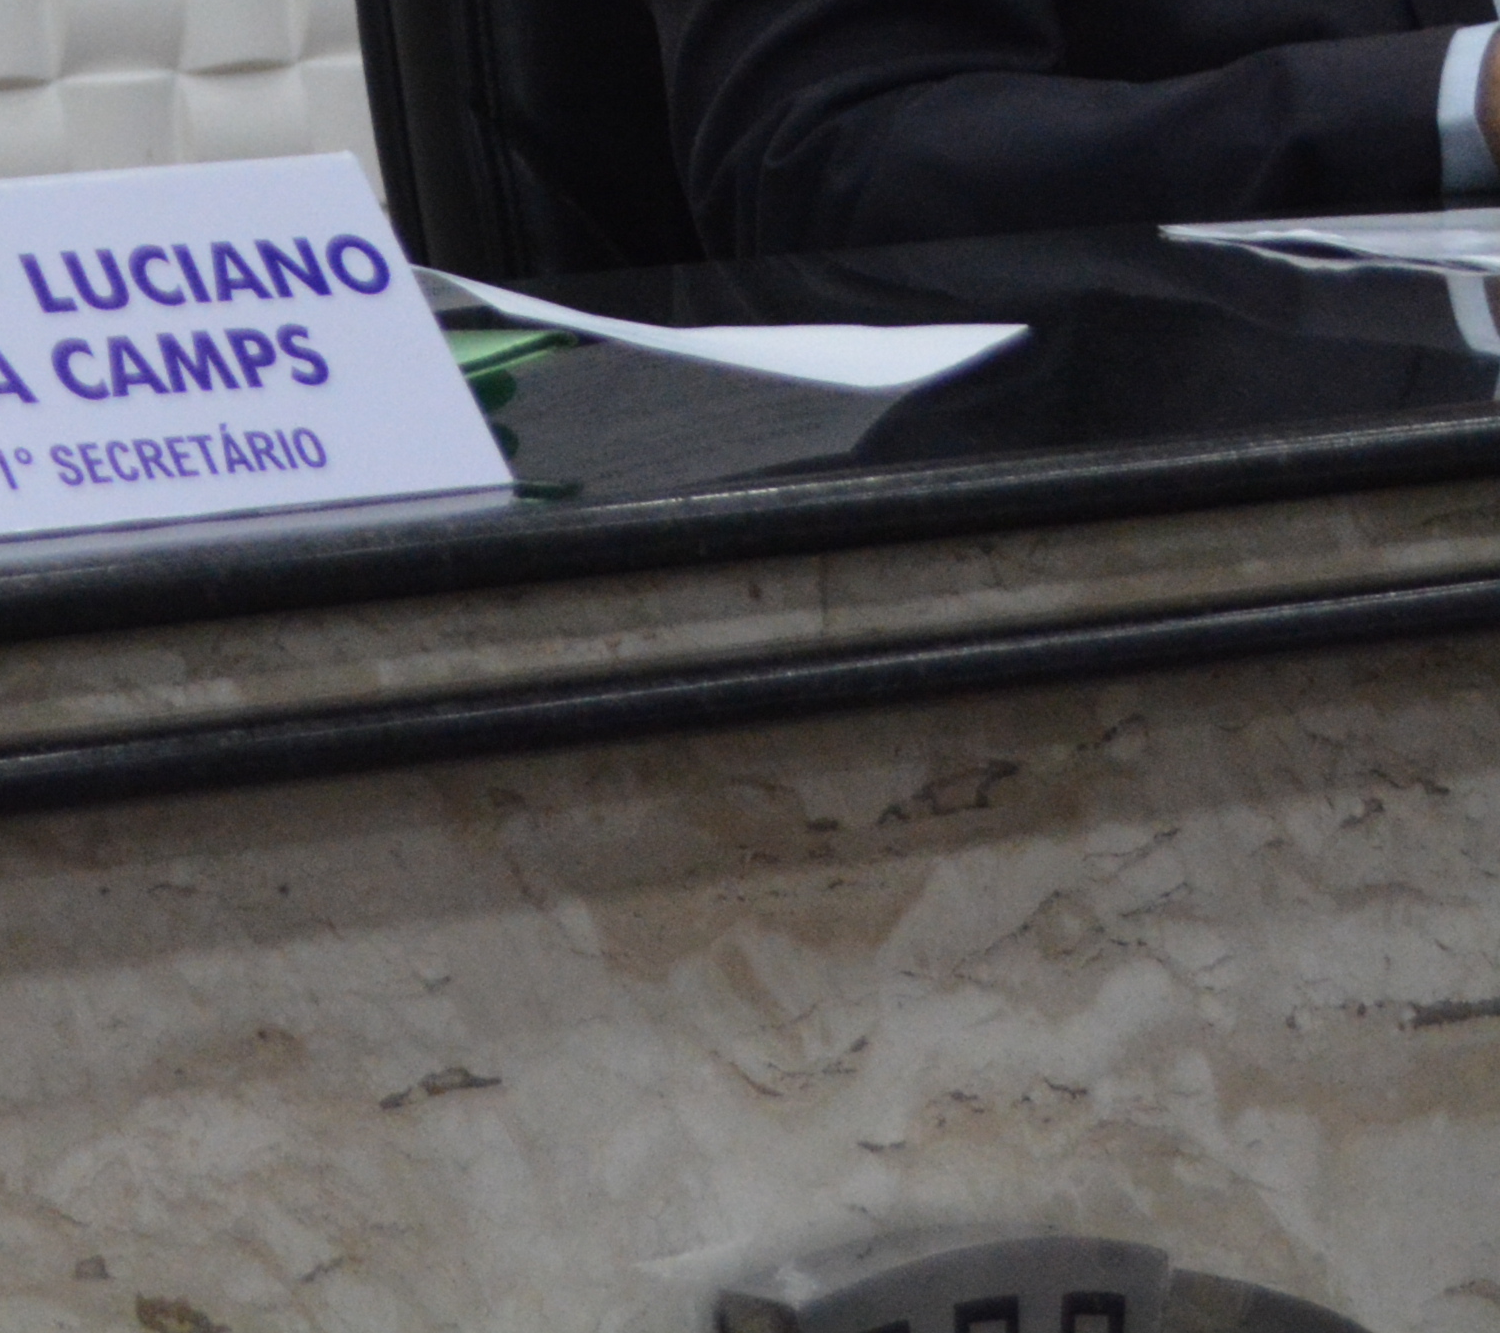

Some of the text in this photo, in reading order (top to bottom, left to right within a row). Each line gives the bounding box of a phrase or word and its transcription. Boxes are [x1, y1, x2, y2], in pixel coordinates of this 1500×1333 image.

[21, 232, 393, 315] LUCIANO
[51, 324, 331, 404] CAMPS
[51, 422, 328, 487] SECRETÁRIO
